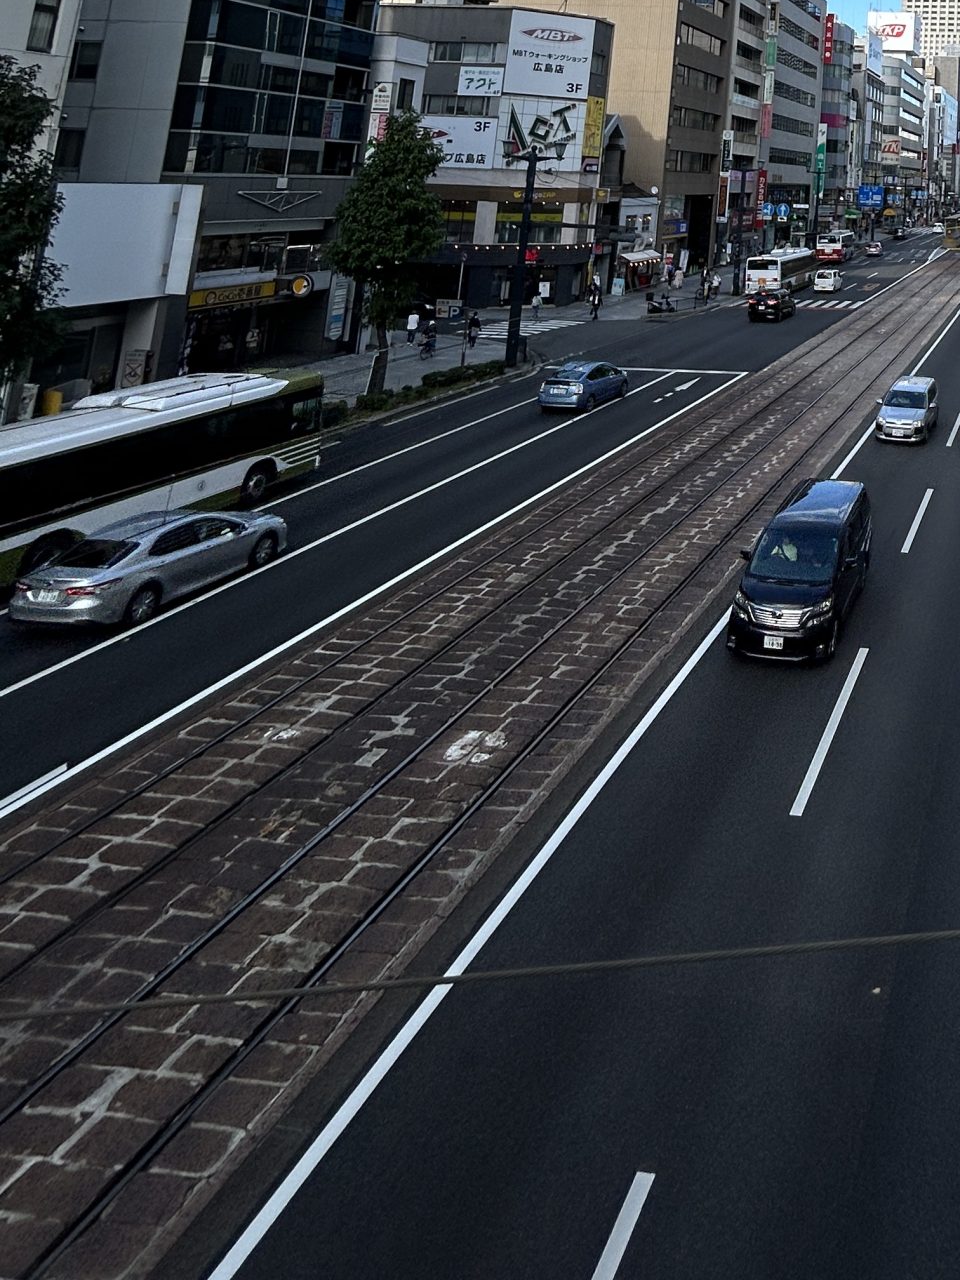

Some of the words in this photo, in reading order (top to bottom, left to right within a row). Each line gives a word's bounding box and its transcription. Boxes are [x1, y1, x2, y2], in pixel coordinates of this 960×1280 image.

[531, 29, 575, 42] MBT
[532, 62, 565, 74] 広島店
[566, 82, 584, 94] 3F
[473, 121, 491, 132] 3F
[449, 306, 460, 318] P
